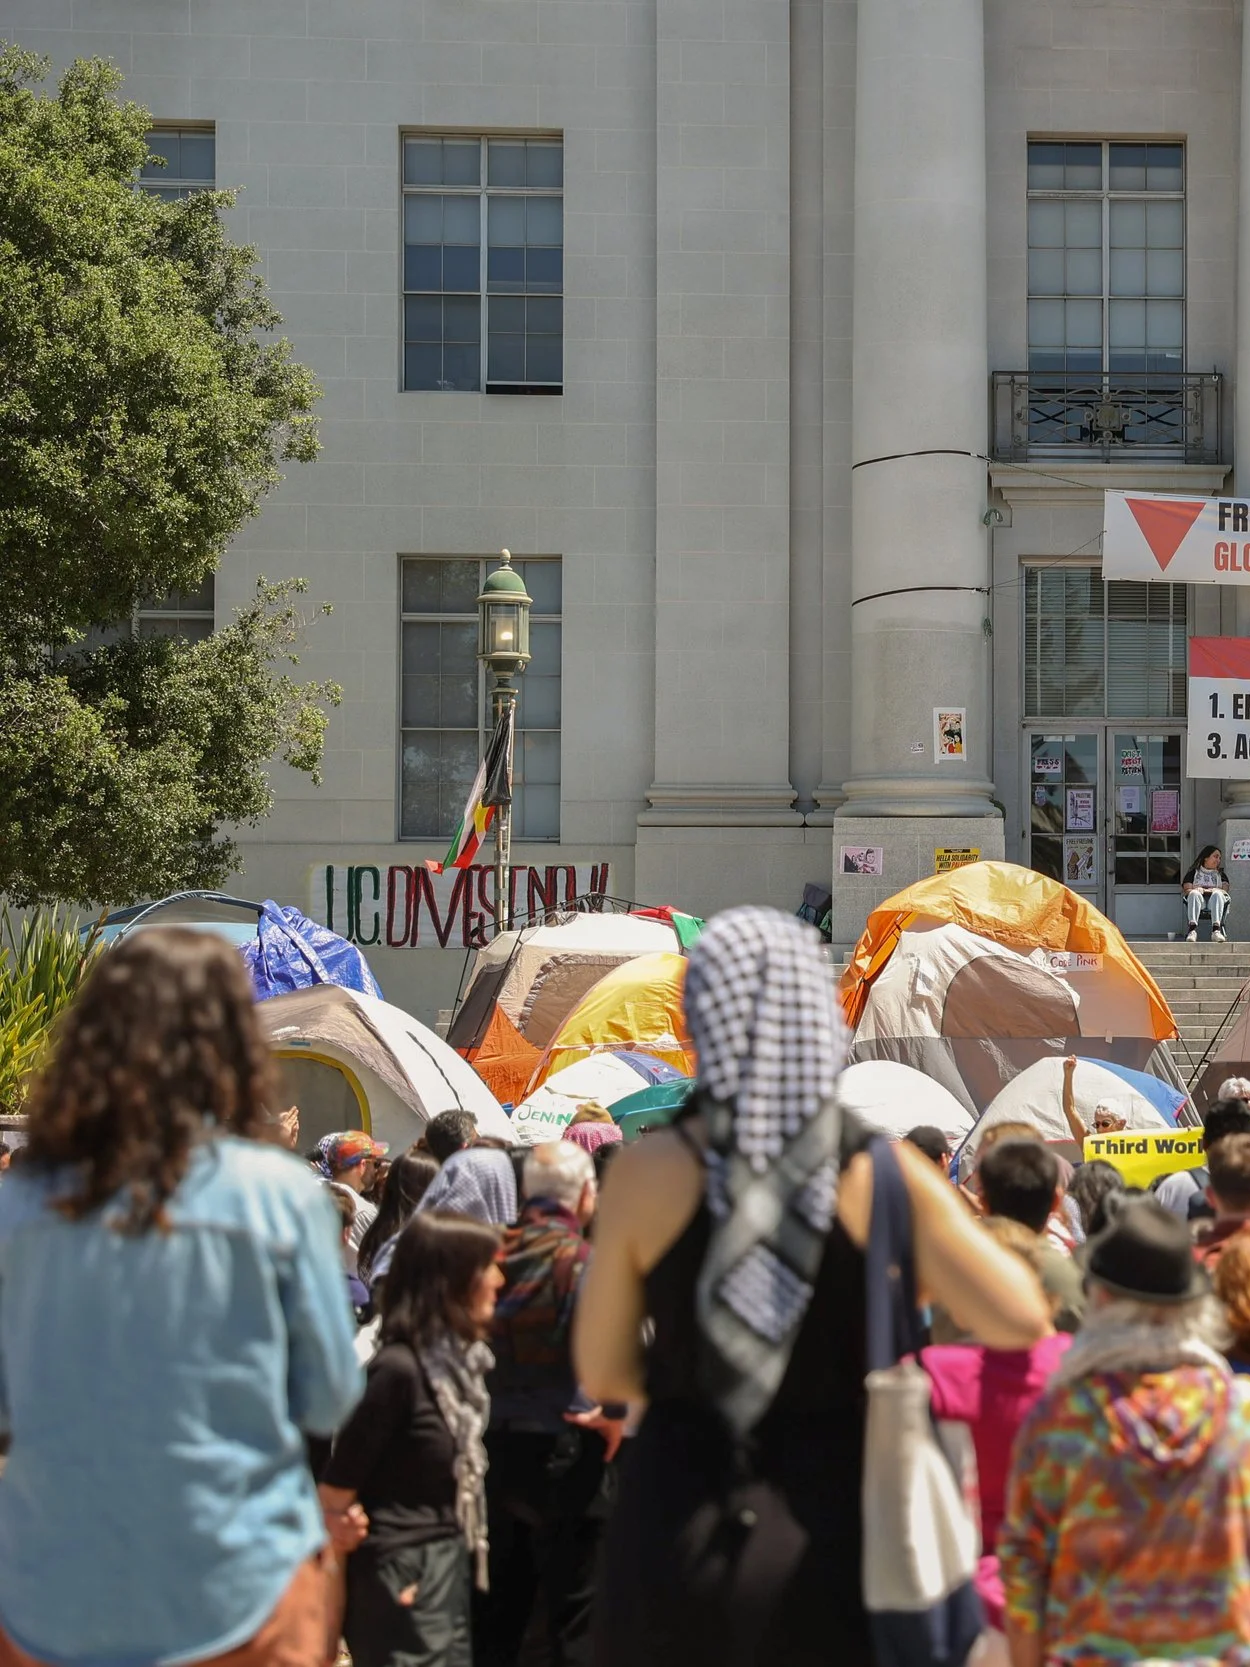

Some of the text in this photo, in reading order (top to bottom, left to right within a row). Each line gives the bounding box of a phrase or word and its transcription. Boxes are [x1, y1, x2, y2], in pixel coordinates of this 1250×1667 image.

[1208, 692, 1225, 719] 1.
[1207, 732, 1228, 760] 3.
[517, 1103, 573, 1126] JENIN
[1090, 1138, 1149, 1155] Third
[1154, 1138, 1204, 1154] Worl
